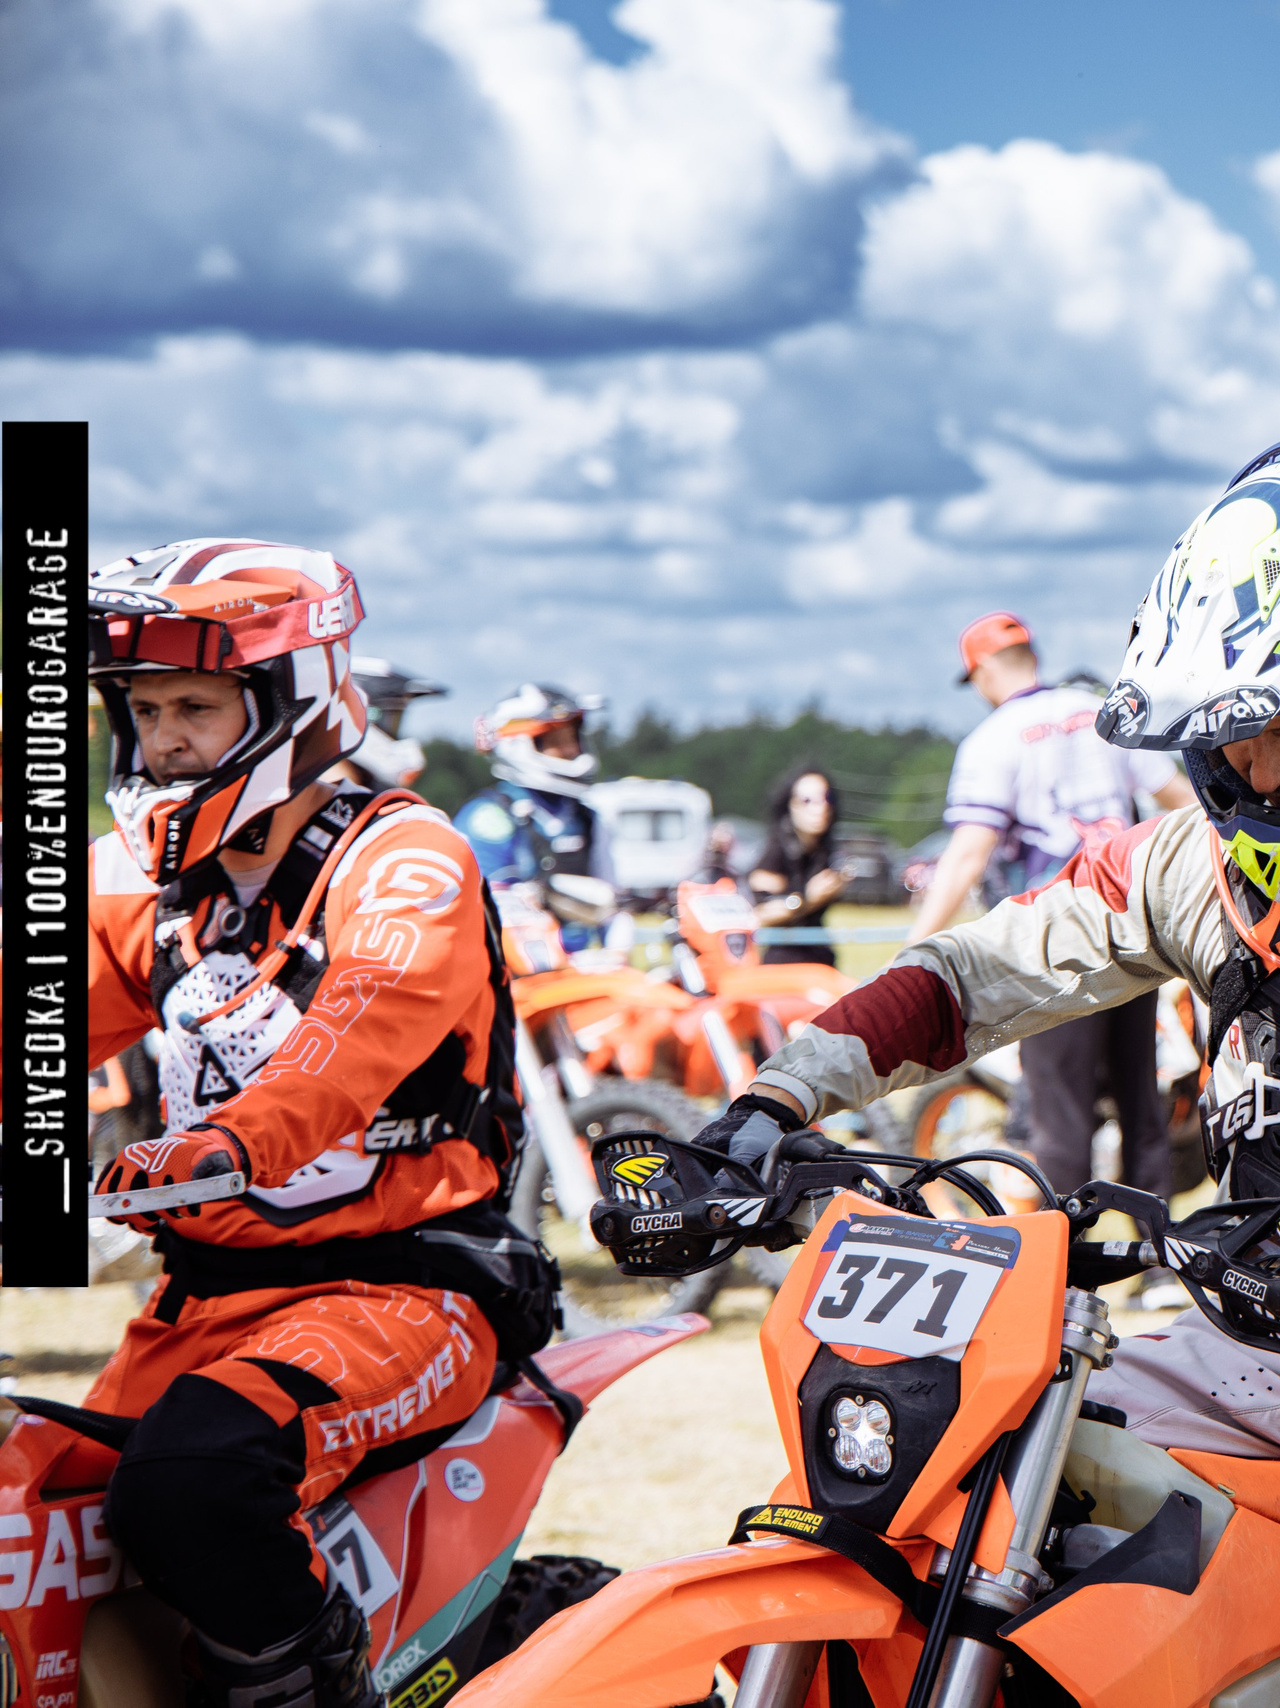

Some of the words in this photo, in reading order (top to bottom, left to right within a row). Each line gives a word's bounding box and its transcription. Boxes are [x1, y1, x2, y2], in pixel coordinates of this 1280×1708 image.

[1179, 689, 1276, 741] Airoh
[631, 1212, 683, 1233] CYCRA
[817, 1254, 968, 1338] 371
[1222, 1269, 1268, 1302] CYCRA
[772, 1517, 819, 1534] ELEMENT
[773, 1507, 824, 1526] ENDURO
[327, 1528, 371, 1596] 7
